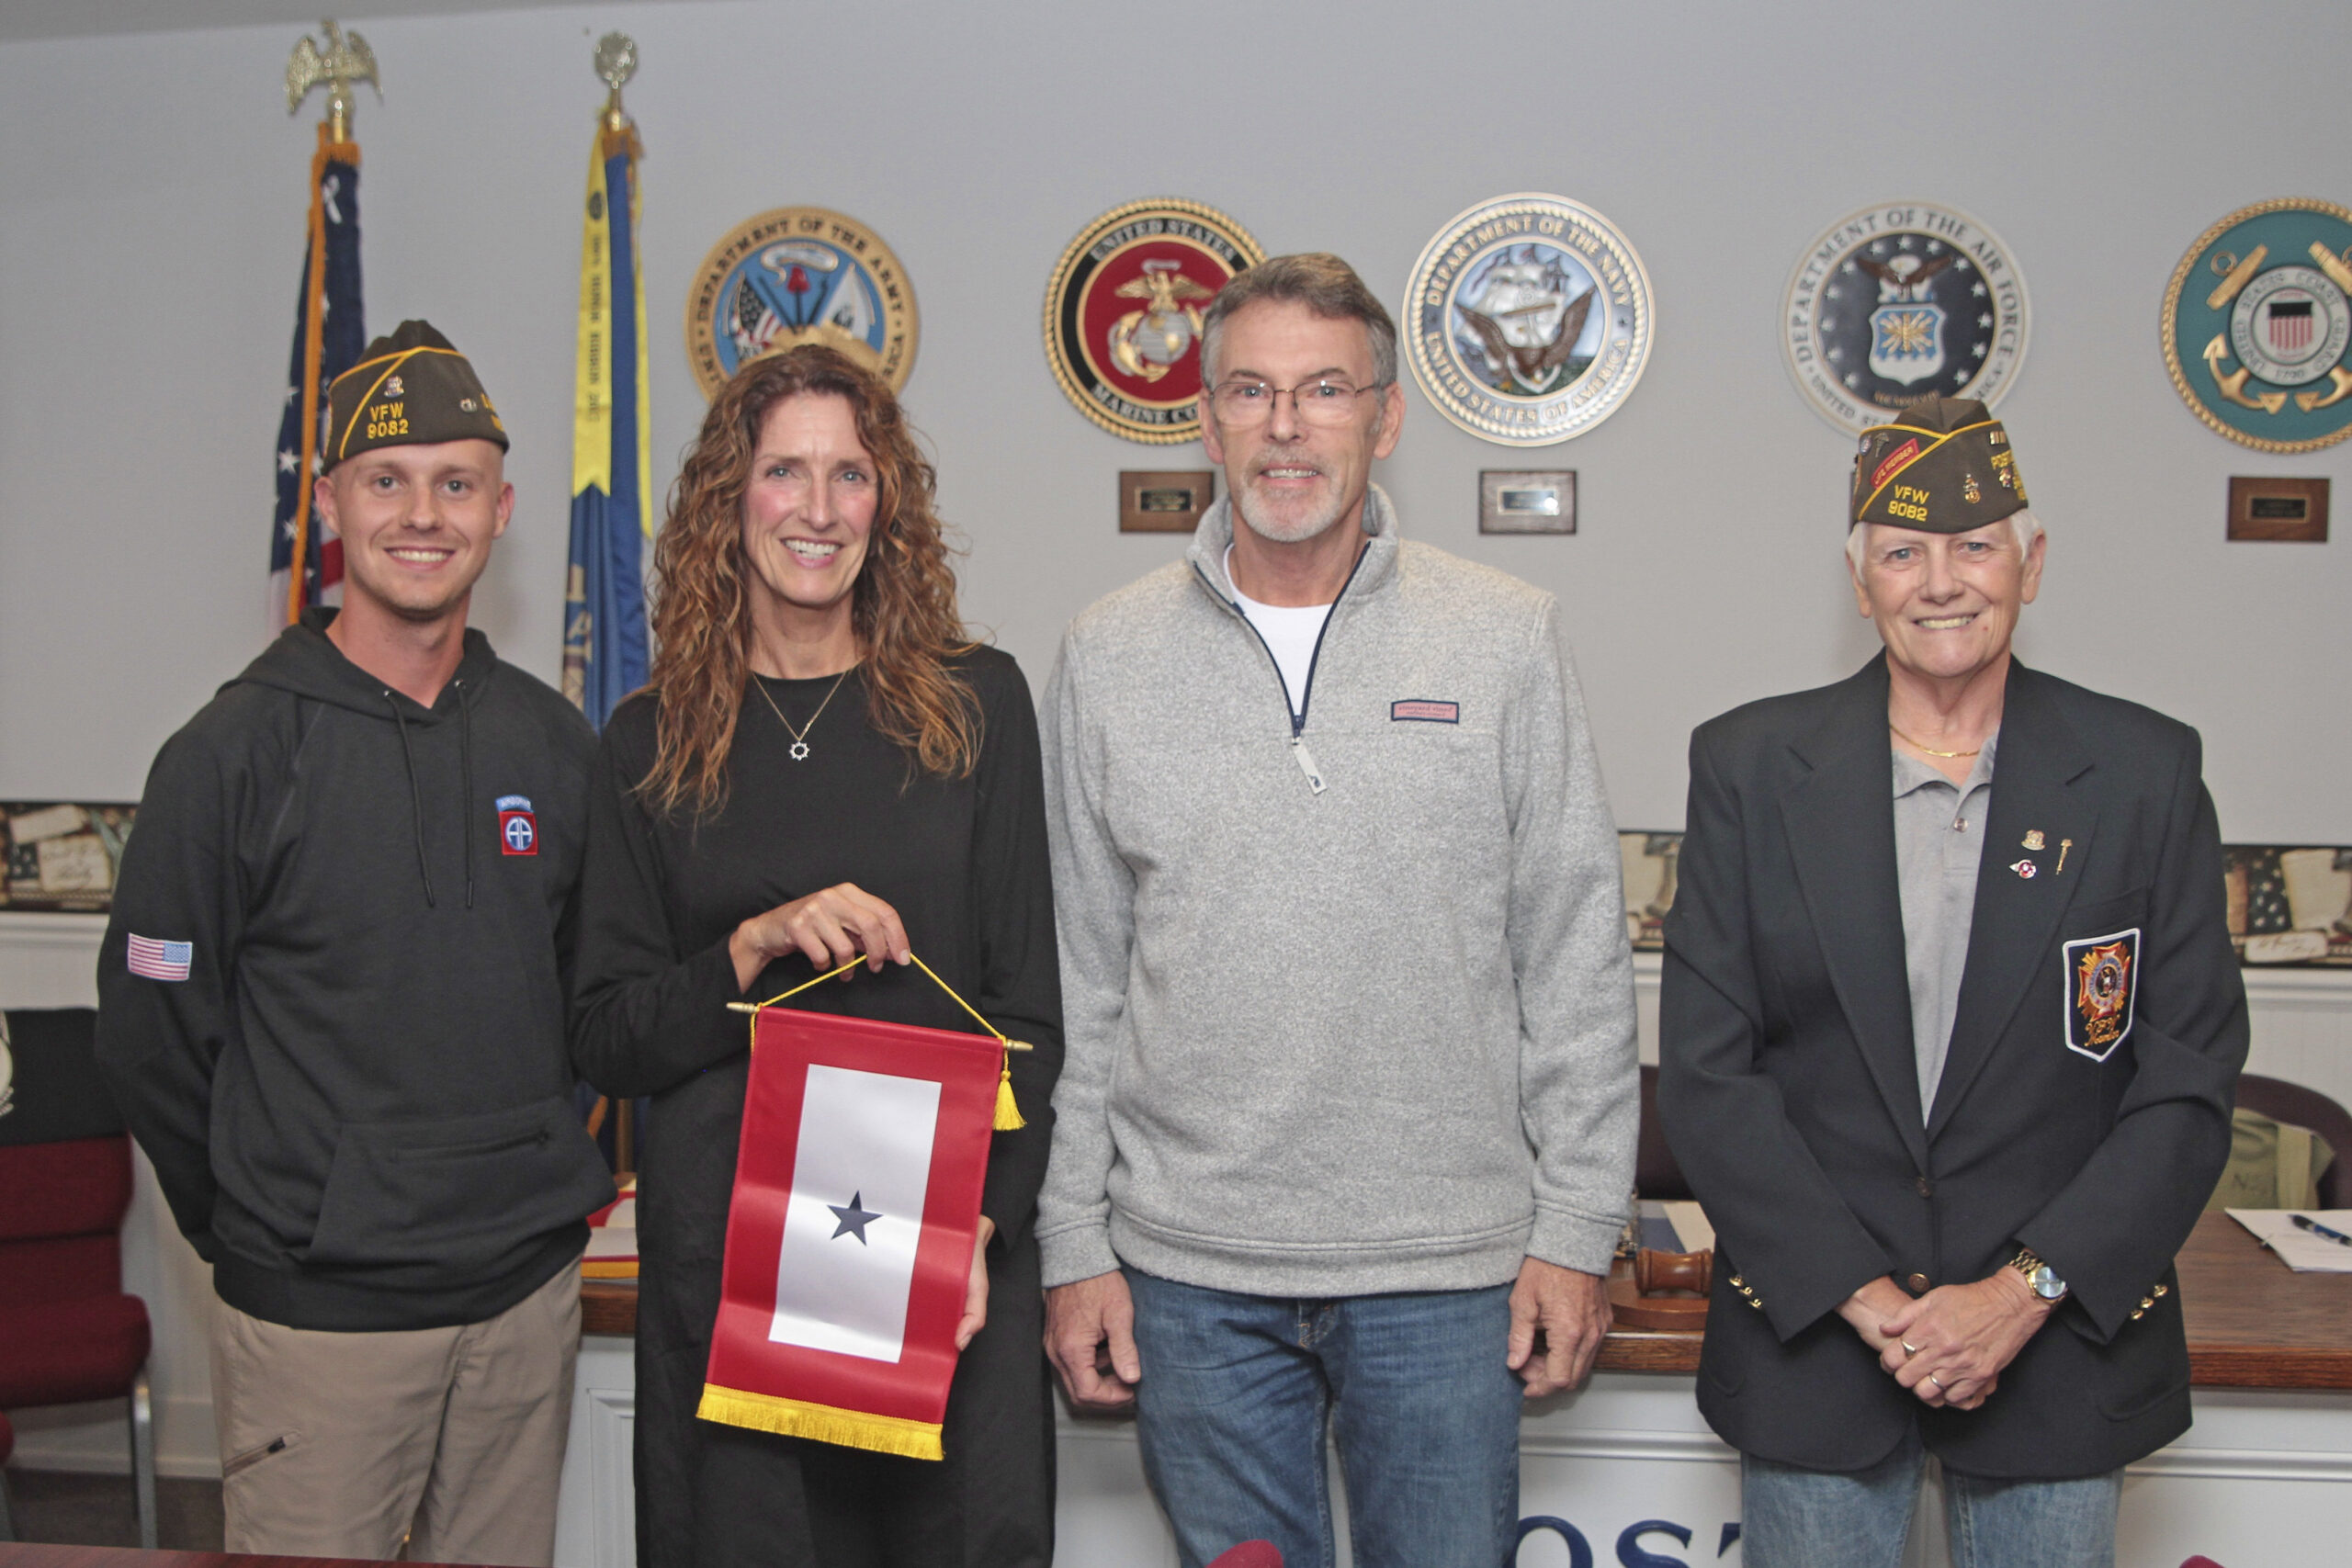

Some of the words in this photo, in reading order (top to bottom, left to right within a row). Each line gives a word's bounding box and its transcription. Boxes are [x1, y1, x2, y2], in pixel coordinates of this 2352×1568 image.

[1091, 220, 1164, 261] UNITED
[1167, 220, 1237, 261] STATES
[696, 220, 790, 319] DEPARTMENT
[798, 219, 825, 231] OF
[831, 225, 866, 253] THE
[869, 258, 904, 311] ARMY
[1427, 217, 1532, 307] DEPARTMENT
[1538, 218, 1564, 237] OF
[1567, 226, 1601, 258] THE
[1597, 254, 1631, 306] NAVY
[1792, 215, 1878, 364] DEPARTMENT
[1886, 209, 1917, 227] OF
[1925, 212, 1969, 242] THE
[1971, 240, 2004, 275] AIR
[1997, 280, 2018, 357] FORCE
[1426, 332, 1471, 399] UNITED
[1470, 394, 1538, 424] STATES
[1543, 402, 1568, 422] OF
[1572, 339, 1628, 411] AMERICA
[1811, 375, 1856, 420] UNITED
[369, 401, 404, 422] VFW
[1091, 383, 1168, 425] MARINE
[368, 419, 409, 439] 9082
[1884, 446, 1914, 471] MEMBER
[1888, 501, 1928, 522] 9082
[1894, 485, 1929, 504] VFW
